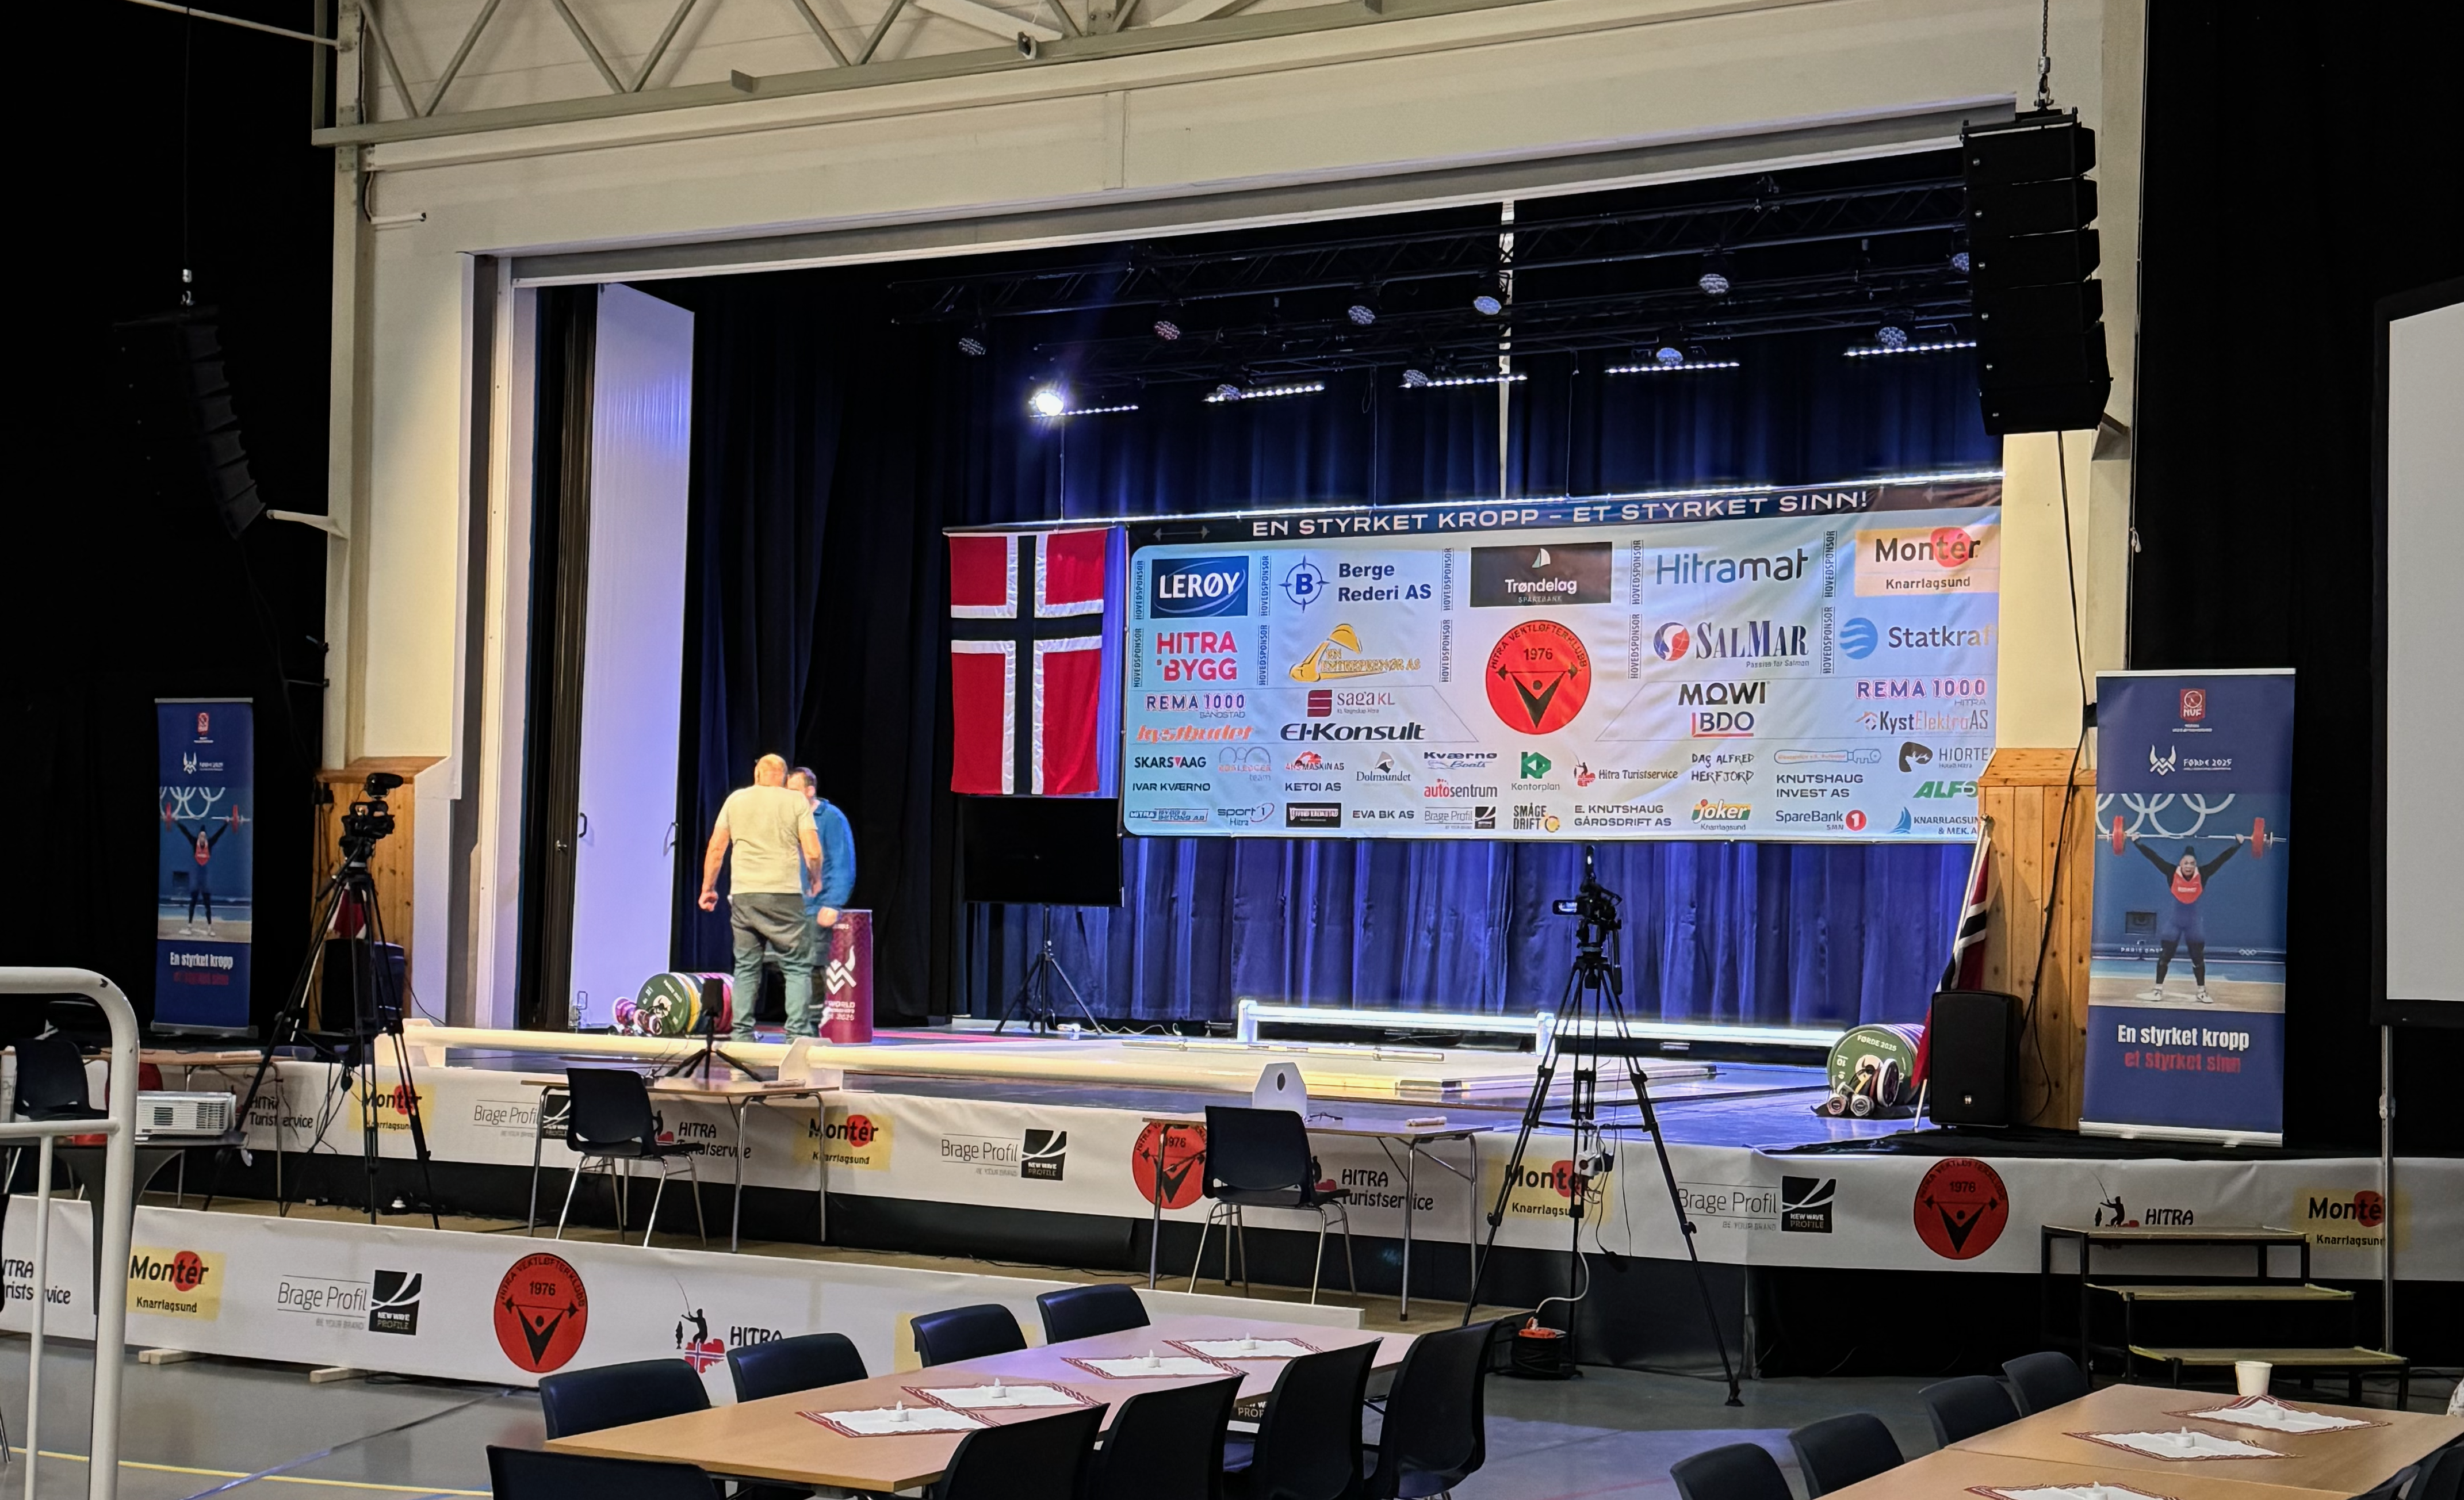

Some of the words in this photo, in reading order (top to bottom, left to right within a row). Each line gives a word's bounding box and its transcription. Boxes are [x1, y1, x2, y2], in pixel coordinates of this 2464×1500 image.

[1253, 522, 1288, 536] EN
[1300, 514, 1428, 535] STYRKET
[1439, 509, 1539, 529] KROPP
[1573, 506, 1610, 523] ET
[1621, 498, 1767, 521] STYRKET
[1779, 491, 1867, 512] SINN!
[1876, 534, 1981, 562] Montér
[1339, 563, 1395, 580] Berge
[1633, 539, 1642, 605] HOVEDSPONSOR
[1657, 548, 1808, 585] Hitramat
[1825, 531, 1836, 598] HOVEDSPONSOR
[1159, 571, 1240, 599] LERØY
[1261, 556, 1270, 616] HOVEDSPONSOR
[1444, 548, 1453, 611] HOVEDSPONSOR
[1505, 577, 1577, 595] Trøndelag
[1886, 576, 1971, 590] Knarrlagsund
[1135, 561, 1145, 619] HOVEDSPONSOR
[1338, 585, 1399, 602] Rederi
[1405, 584, 1432, 599] AS
[1157, 631, 1238, 655] HITRA
[1631, 614, 1640, 679] HOVEDSPONSOR
[1823, 607, 1834, 674] HOVEDSPONSOR
[1133, 627, 1142, 687] HOVEDSPONSOR
[1258, 625, 1268, 686] HOVEDSPONSOR
[1442, 619, 1451, 683] HOVEDSPONSOR
[1524, 648, 1554, 661] 1976
[1164, 659, 1237, 682] BYGG
[1678, 682, 1766, 706] MOWI
[1858, 680, 1926, 698] REMA
[1933, 679, 1985, 698] 1000
[1146, 694, 1199, 710] REMA
[1203, 694, 1245, 710] 1000
[1378, 692, 1396, 706] KL
[1954, 698, 1987, 707] HITRA
[1700, 711, 1755, 732] BDO
[1716, 753, 1755, 766] ALFRED
[1356, 771, 1411, 782] Dolmsundet
[1599, 770, 1620, 780] Hitra
[1623, 769, 1678, 780] Turistservice
[1691, 770, 1754, 785] HERFJORD
[1777, 775, 1864, 784] KNUTSHAUG
[1132, 783, 1157, 792] IVAR
[1325, 783, 1342, 791] AS
[1424, 783, 1498, 798] autosentrum
[1511, 783, 1560, 791] Kontorplan
[1777, 789, 1827, 798] INVEST
[1830, 789, 1850, 798] AS
[1353, 810, 1375, 819] EVA
[1379, 810, 1395, 819] BK
[1398, 810, 1415, 819] AS
[1424, 810, 1448, 823] Brage
[1451, 810, 1473, 821] Profil
[1513, 802, 1547, 817] SMÅGE
[1575, 805, 1585, 814] E.
[1589, 805, 1663, 814] KNUTSHAUG
[1693, 799, 1747, 824] joker
[1776, 810, 1843, 824] SpareBank
[1513, 818, 1541, 830] DRIFT
[1574, 816, 1651, 826] GÅRDSDRIFT
[1655, 818, 1672, 826] AS
[1857, 1035, 1880, 1047] FØRDE
[1880, 1041, 1897, 1052] 2025
[2118, 1024, 2136, 1043] En
[2140, 1025, 2198, 1047] styrket
[2202, 1028, 2250, 1051] kropp
[2124, 1050, 2140, 1068] et
[2145, 1050, 2202, 1072] styrket
[474, 1105, 507, 1126] Brage
[510, 1107, 538, 1124] Profi
[679, 1122, 717, 1138] HITRA
[942, 1139, 979, 1162] Brage
[983, 1142, 1018, 1162] Profil
[1342, 1168, 1388, 1187] HITRA
[1678, 1188, 1727, 1214] Brage
[1732, 1192, 1777, 1214] Profil
[2308, 1197, 2382, 1220] Monté
[1790, 1220, 1824, 1229] PROFILE
[2145, 1208, 2194, 1226] HITRA
[3, 1259, 34, 1279] ITRA
[130, 1255, 209, 1285] Montér
[277, 1283, 323, 1308] Brage
[326, 1286, 368, 1311] Profil
[529, 1281, 556, 1296] 1976
[136, 1296, 197, 1313] Knarrlagsund
[377, 1319, 410, 1330] PROFILE
